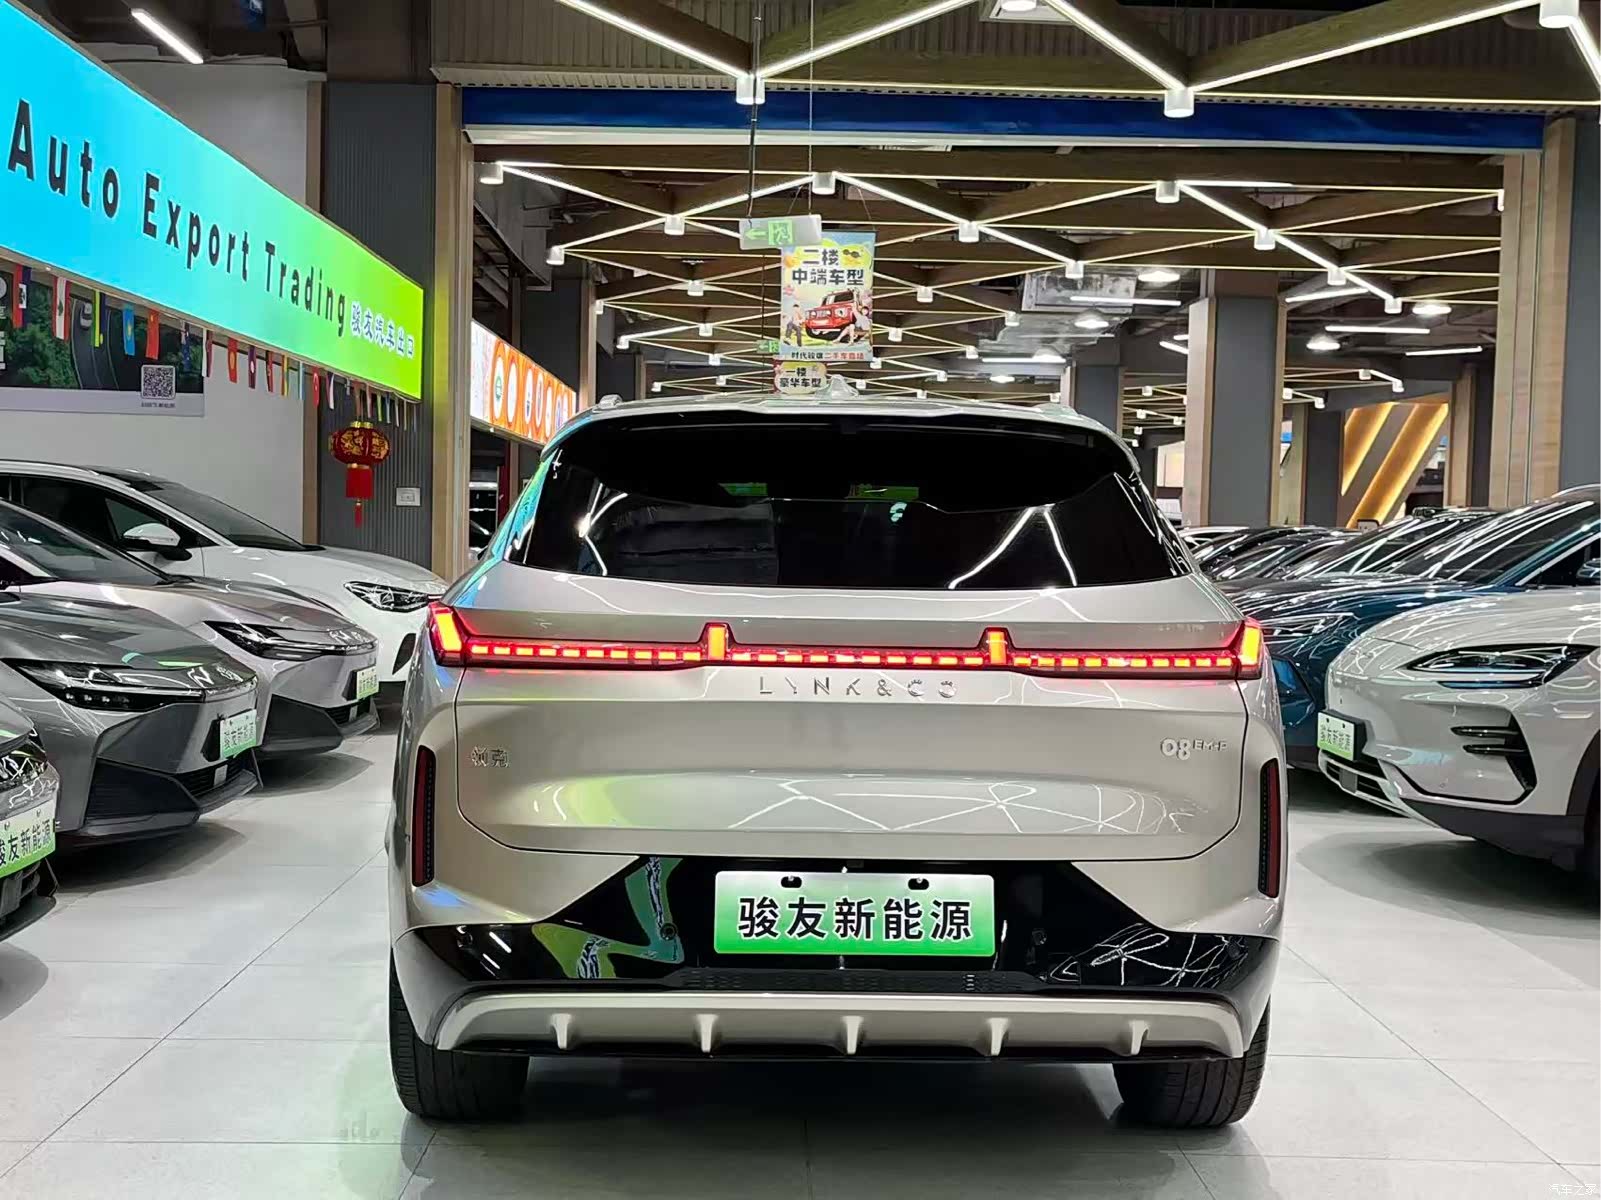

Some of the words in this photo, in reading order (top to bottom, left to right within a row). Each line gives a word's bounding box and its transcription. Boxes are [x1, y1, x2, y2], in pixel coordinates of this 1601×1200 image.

[8, 98, 119, 218] Auto
[143, 172, 249, 282] Export
[265, 240, 345, 337] Trading
[802, 249, 839, 266] 二楼
[792, 268, 865, 286] 中端车型
[738, 896, 974, 941] 骏友新能源
